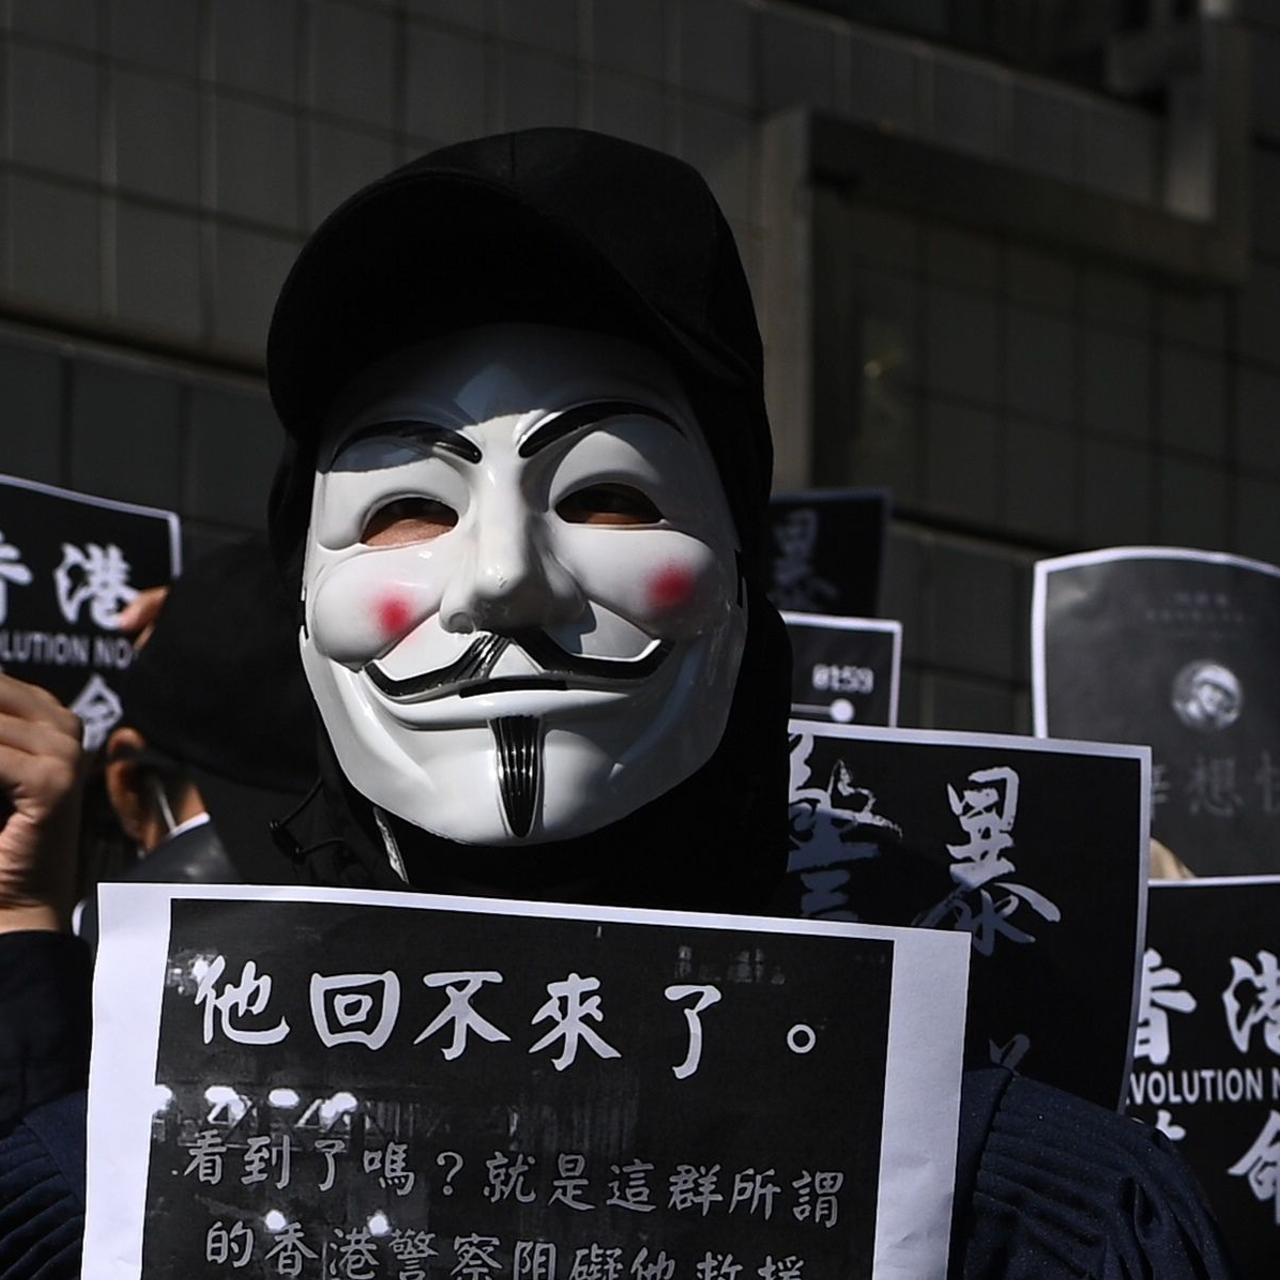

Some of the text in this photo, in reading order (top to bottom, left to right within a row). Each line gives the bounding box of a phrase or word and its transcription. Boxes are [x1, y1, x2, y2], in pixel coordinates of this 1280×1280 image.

[93, 637, 138, 672] NO
[192, 954, 818, 1080] 他回不來了。
[1126, 1067, 1263, 1106] VOLUTION
[184, 1129, 844, 1229] 看到了嗎？就是這群所謂
